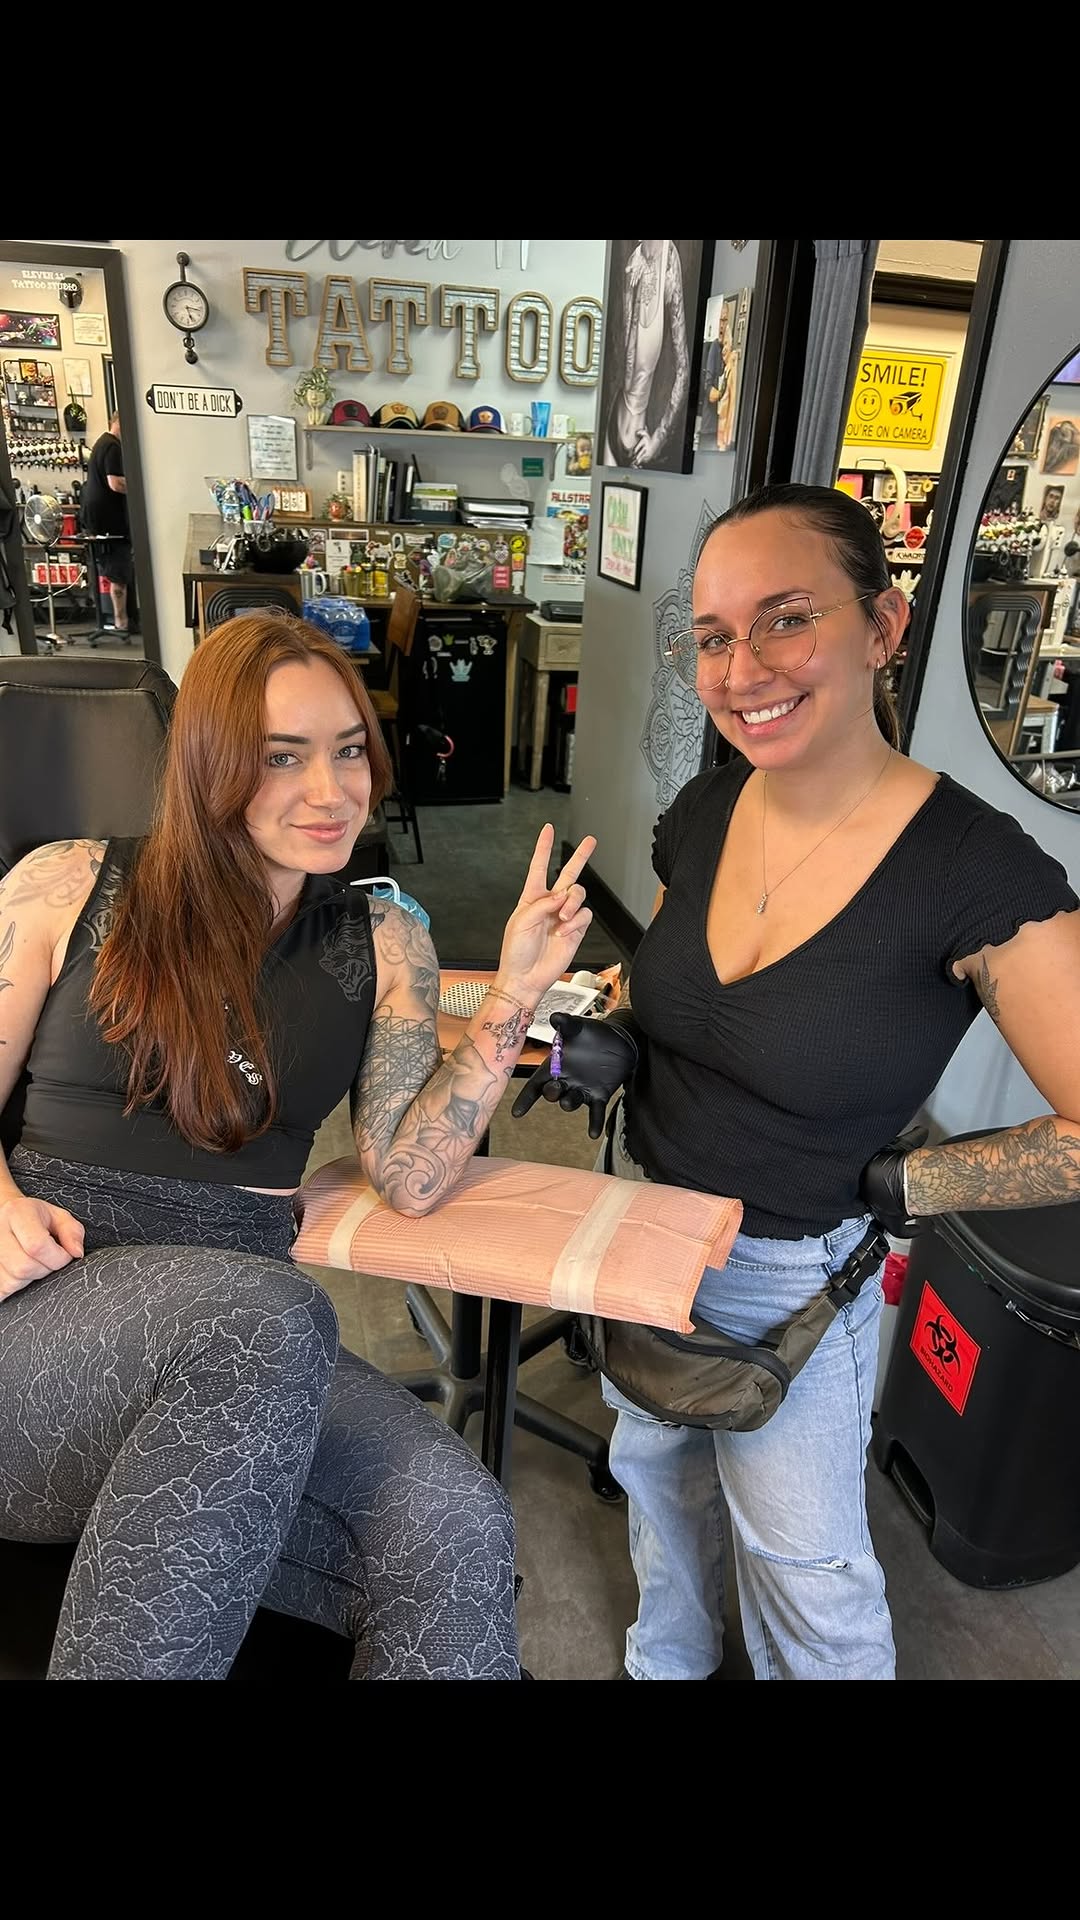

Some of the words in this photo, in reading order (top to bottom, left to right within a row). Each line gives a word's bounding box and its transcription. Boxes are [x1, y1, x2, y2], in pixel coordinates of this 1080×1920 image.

[12, 280, 46, 289] TATTOO
[48, 282, 78, 291] STUDIO
[243, 267, 602, 386] TATTOO
[860, 362, 927, 387] SMILE!
[157, 391, 184, 410] DON'T
[188, 393, 200, 411] BE
[203, 393, 208, 412] A
[210, 394, 232, 413] DICK
[846, 423, 873, 437] OU'RE
[876, 425, 889, 438] ON
[892, 426, 927, 440] CAMERA
[920, 1345, 953, 1393] BIOHAZARD
